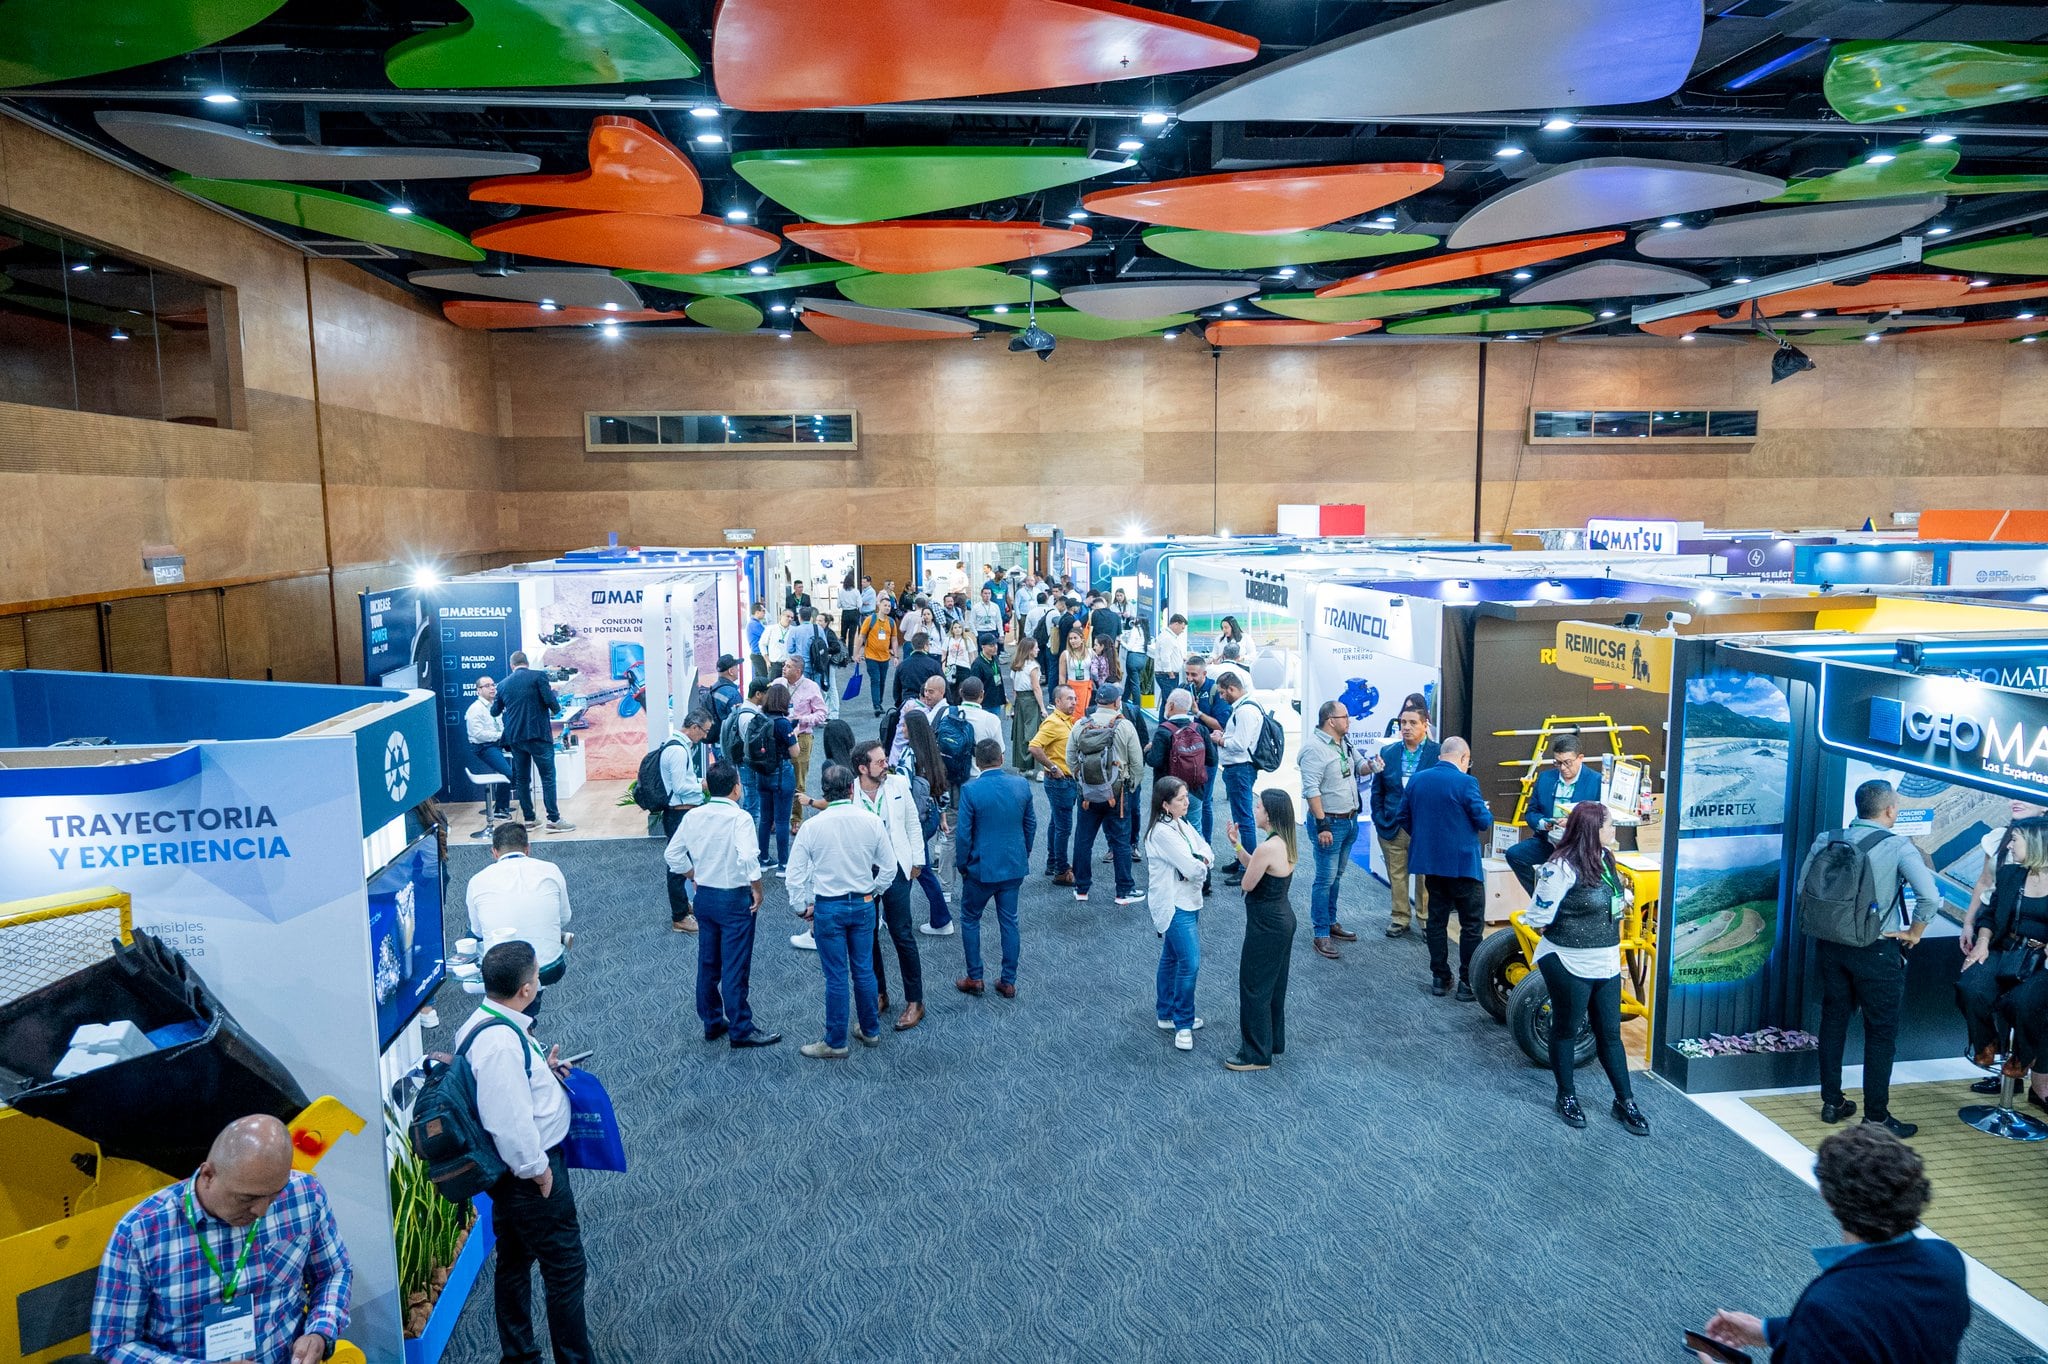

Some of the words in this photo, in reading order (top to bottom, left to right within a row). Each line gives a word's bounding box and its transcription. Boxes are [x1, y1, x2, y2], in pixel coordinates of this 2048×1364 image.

[156, 567, 183, 578] SALIDA
[1988, 574, 2037, 583] analytics
[1324, 606, 1389, 641] TRAINCOL
[1565, 632, 1626, 661] REMICSA
[1583, 656, 1610, 668] COLOMBIA
[1690, 803, 1756, 817] IMPERTEX
[45, 805, 278, 838] TRAYECTORIA
[49, 847, 70, 870] Y
[79, 836, 291, 869] EXPERIENCIA
[185, 934, 205, 945] las
